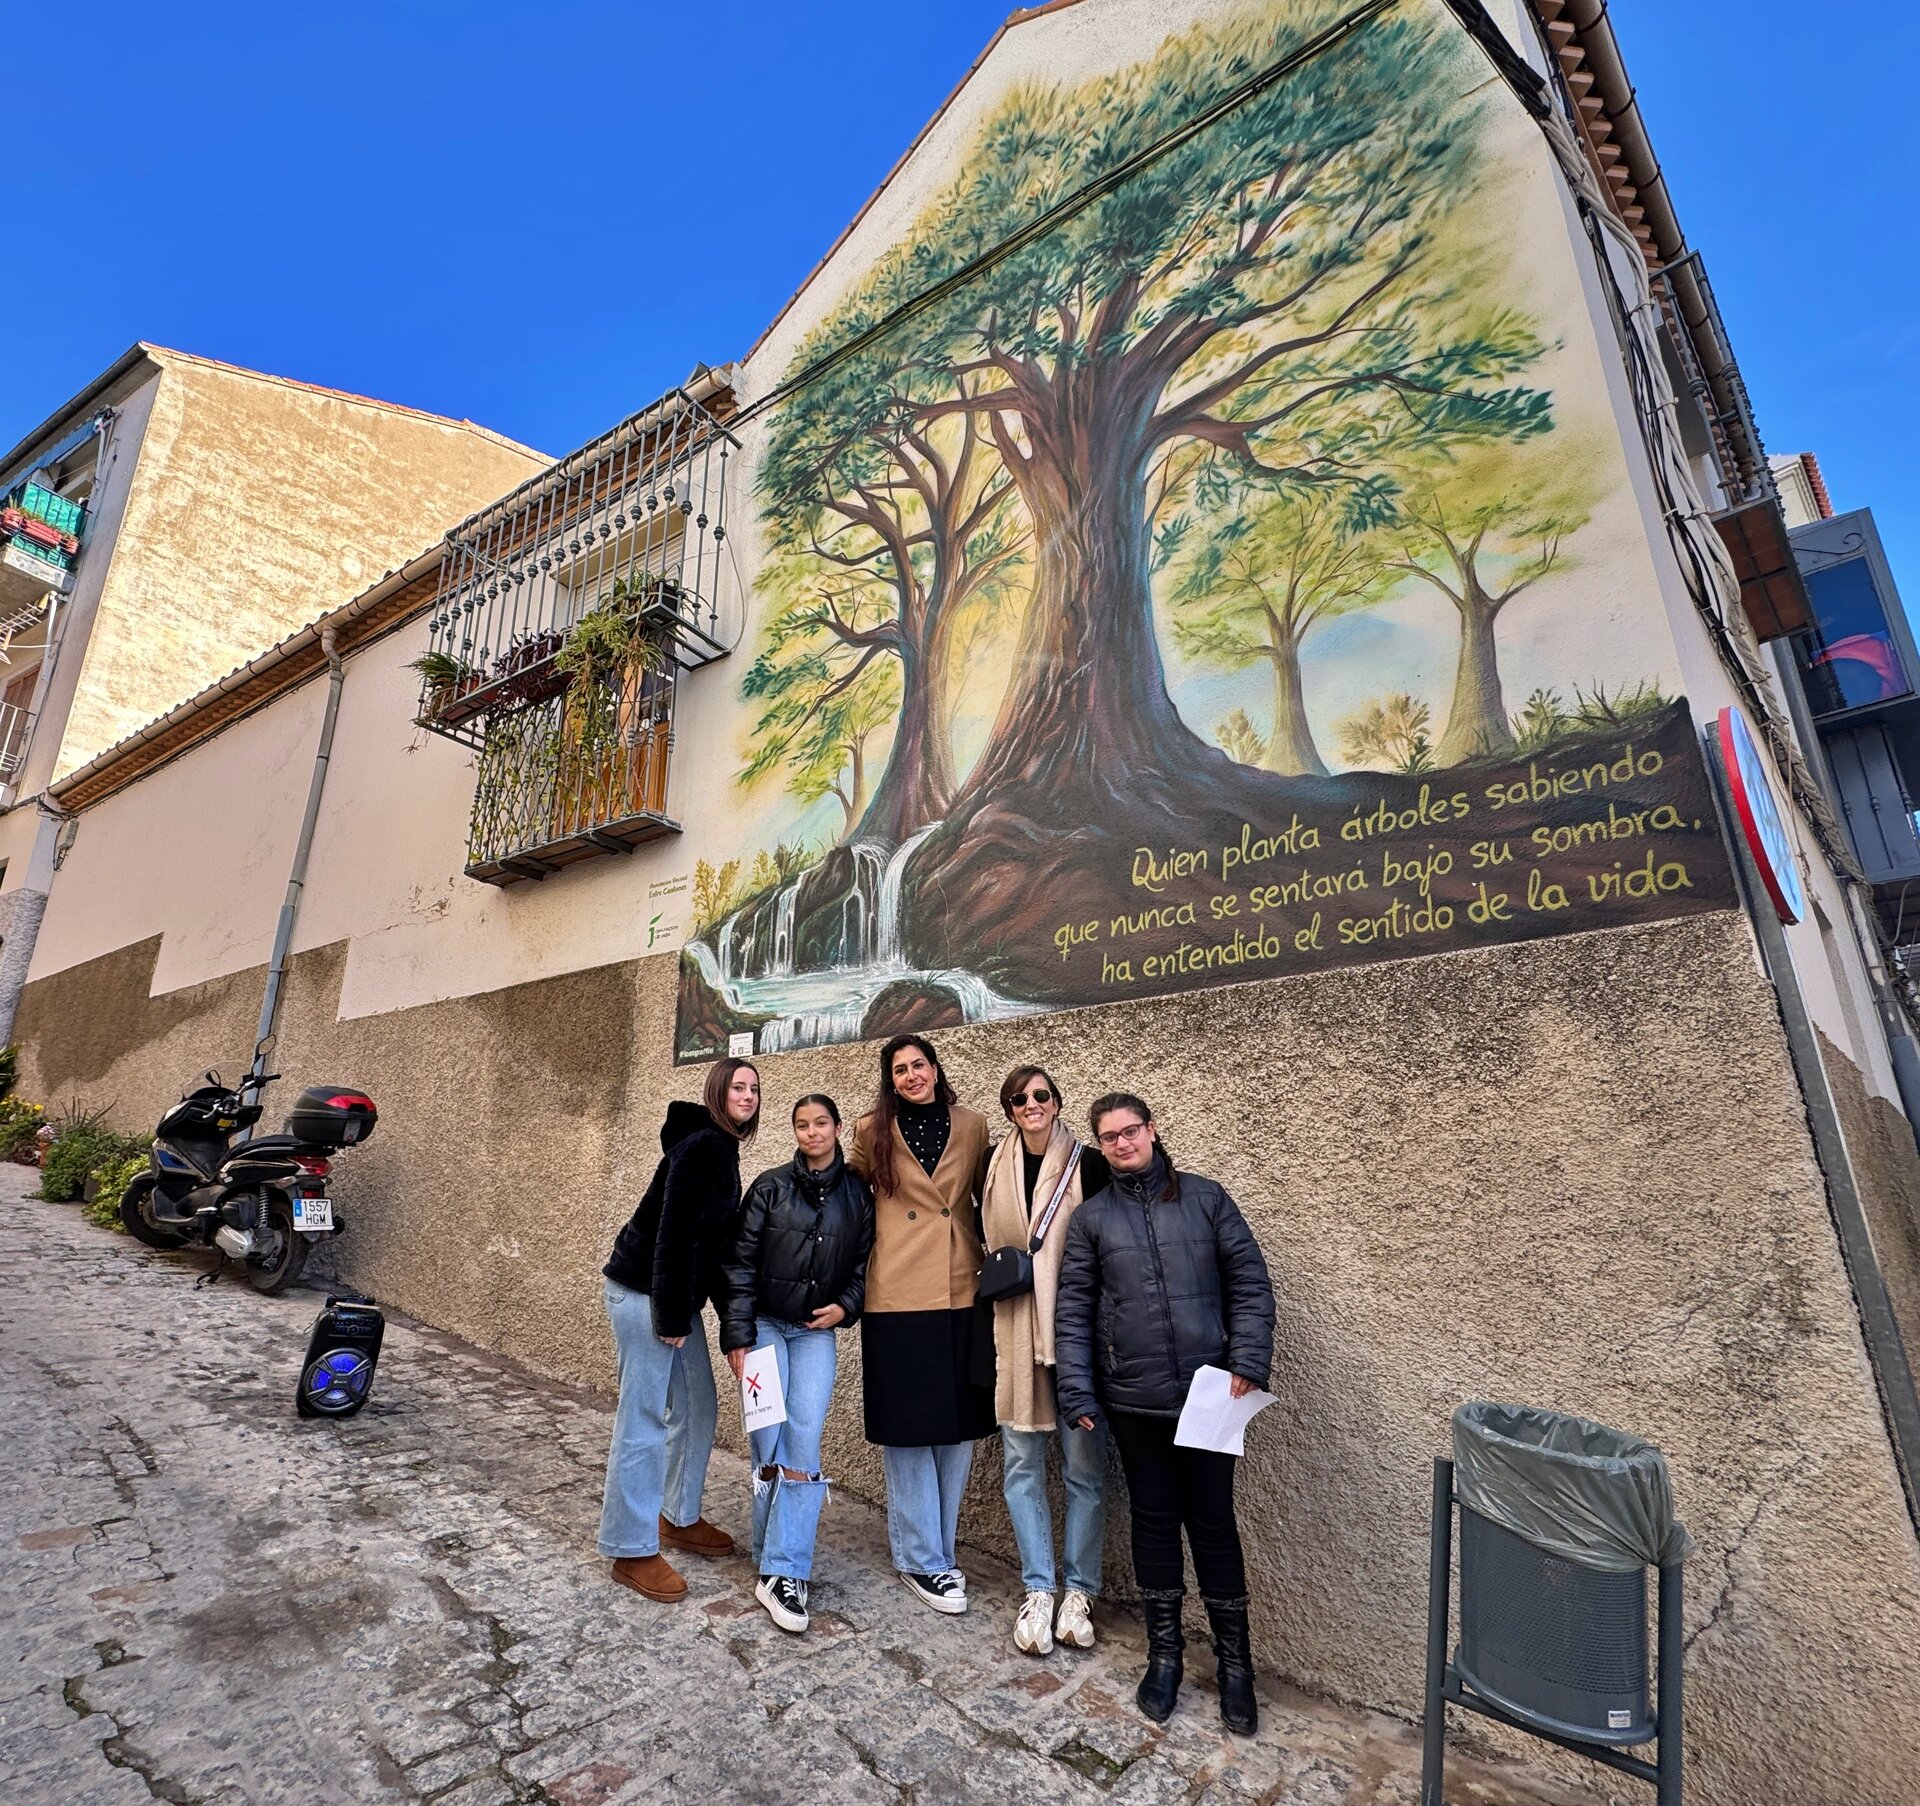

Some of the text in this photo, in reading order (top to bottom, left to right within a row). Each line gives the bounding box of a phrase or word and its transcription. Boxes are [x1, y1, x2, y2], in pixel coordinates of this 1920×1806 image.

[1131, 743, 1664, 893] Quien planta árboles sabiendo
[1053, 920, 1100, 962] que
[1110, 902, 1197, 938] nunca
[1209, 894, 1241, 921] se
[1249, 859, 1369, 914] sentará
[1382, 843, 1453, 897] bajo
[1469, 841, 1514, 869] su
[1101, 849, 1694, 984] ha entendido el sentido de la vida
[303, 1200, 329, 1212] 1557
[305, 1213, 327, 1225] HGM
